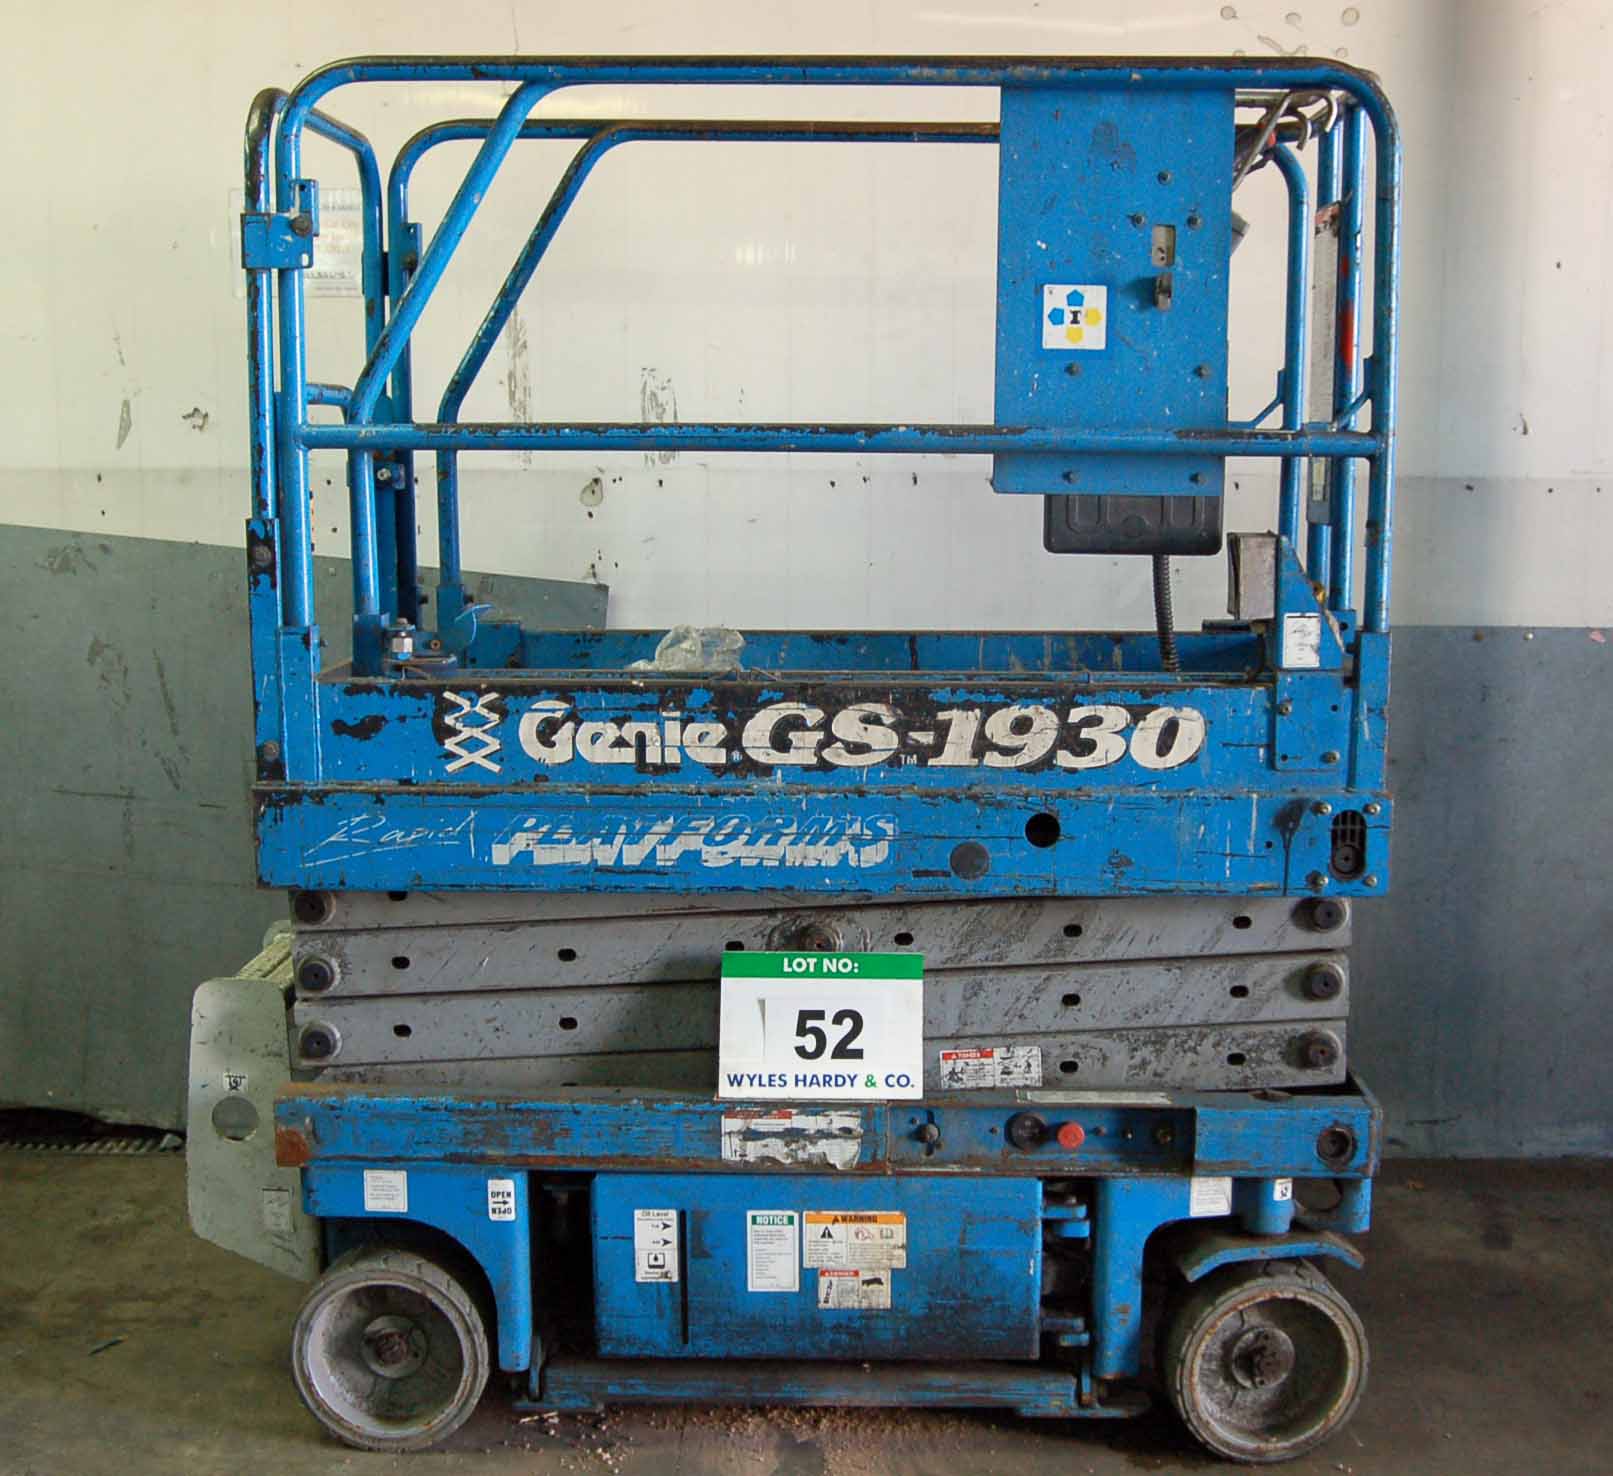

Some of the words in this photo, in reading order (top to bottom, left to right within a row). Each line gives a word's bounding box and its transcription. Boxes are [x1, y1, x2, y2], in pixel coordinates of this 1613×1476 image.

[518, 700, 727, 765] Genie
[742, 701, 1207, 769] GS-1930
[491, 813, 898, 868] PLATFORMS
[783, 957, 818, 973] LOT
[822, 957, 859, 973] NO:
[794, 1008, 864, 1060] 52
[727, 1073, 788, 1088] WYLES
[794, 1073, 858, 1088] HARDY
[865, 1074, 877, 1088] &
[884, 1073, 915, 1088] CO.
[755, 1215, 789, 1225] NOTICE
[840, 1214, 878, 1225] WARNING
